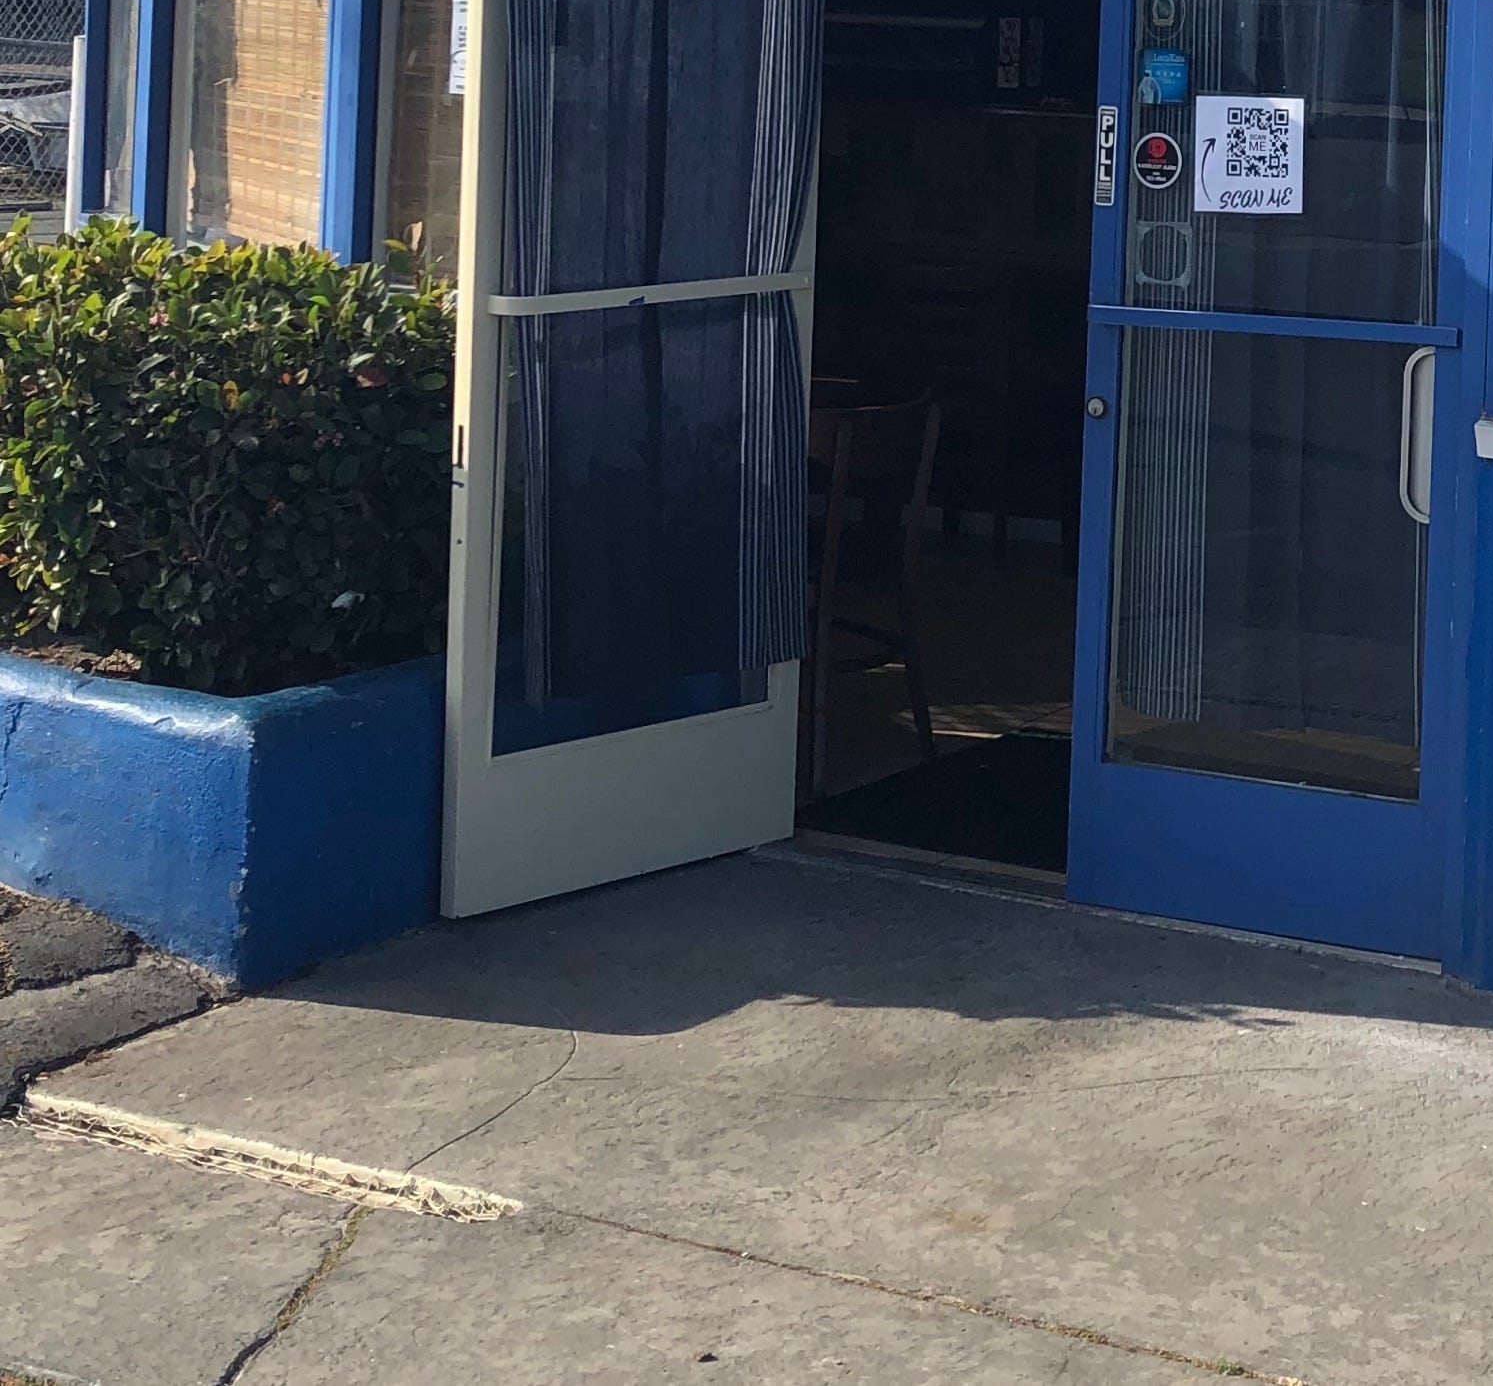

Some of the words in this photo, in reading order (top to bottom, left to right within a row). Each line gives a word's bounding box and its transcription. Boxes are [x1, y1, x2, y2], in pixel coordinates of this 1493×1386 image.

[1099, 115, 1115, 182] PULL
[1248, 141, 1267, 152] ME
[1219, 189, 1264, 210] SCAN
[1266, 186, 1294, 209] ME
